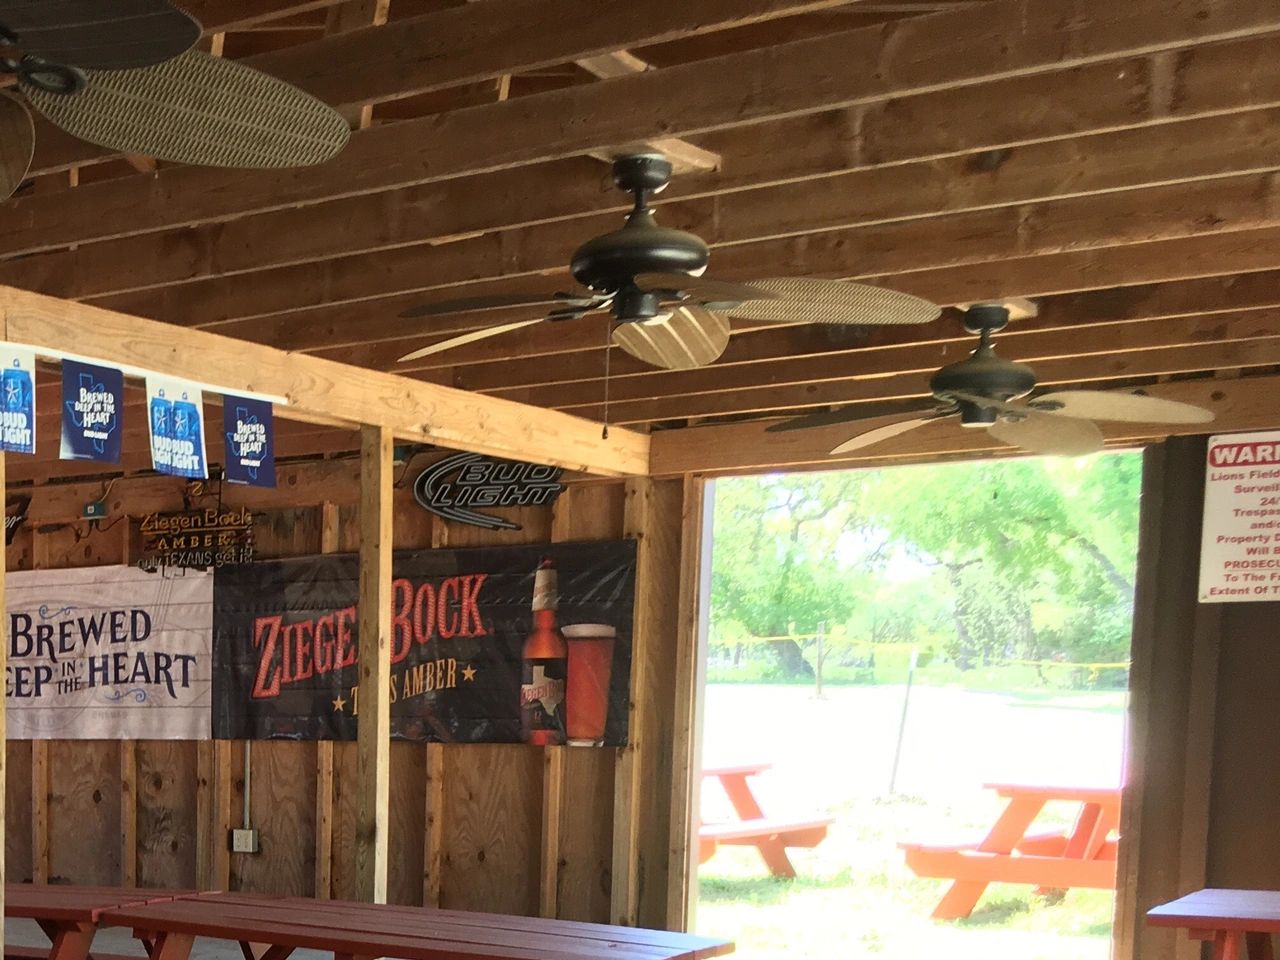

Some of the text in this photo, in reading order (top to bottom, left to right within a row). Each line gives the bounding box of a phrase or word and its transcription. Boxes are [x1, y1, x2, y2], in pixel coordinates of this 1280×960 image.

[4, 411, 27, 429] BUD
[456, 462, 558, 484] BUD
[1210, 472, 1245, 481] Lions
[431, 483, 561, 507] LIGHT
[158, 534, 228, 550] AMBER
[1216, 534, 1271, 544] Property
[163, 551, 212, 568] TEXANS
[1246, 547, 1269, 555] Will
[1224, 573, 1238, 582] To
[1243, 573, 1265, 581] The
[1209, 587, 1249, 596] Extent
[1254, 586, 1268, 594] Of
[10, 610, 152, 663] BREWED
[62, 659, 76, 677] IN
[88, 652, 197, 699] HEART
[57, 677, 81, 695] THE
[402, 658, 457, 700] AMBER
